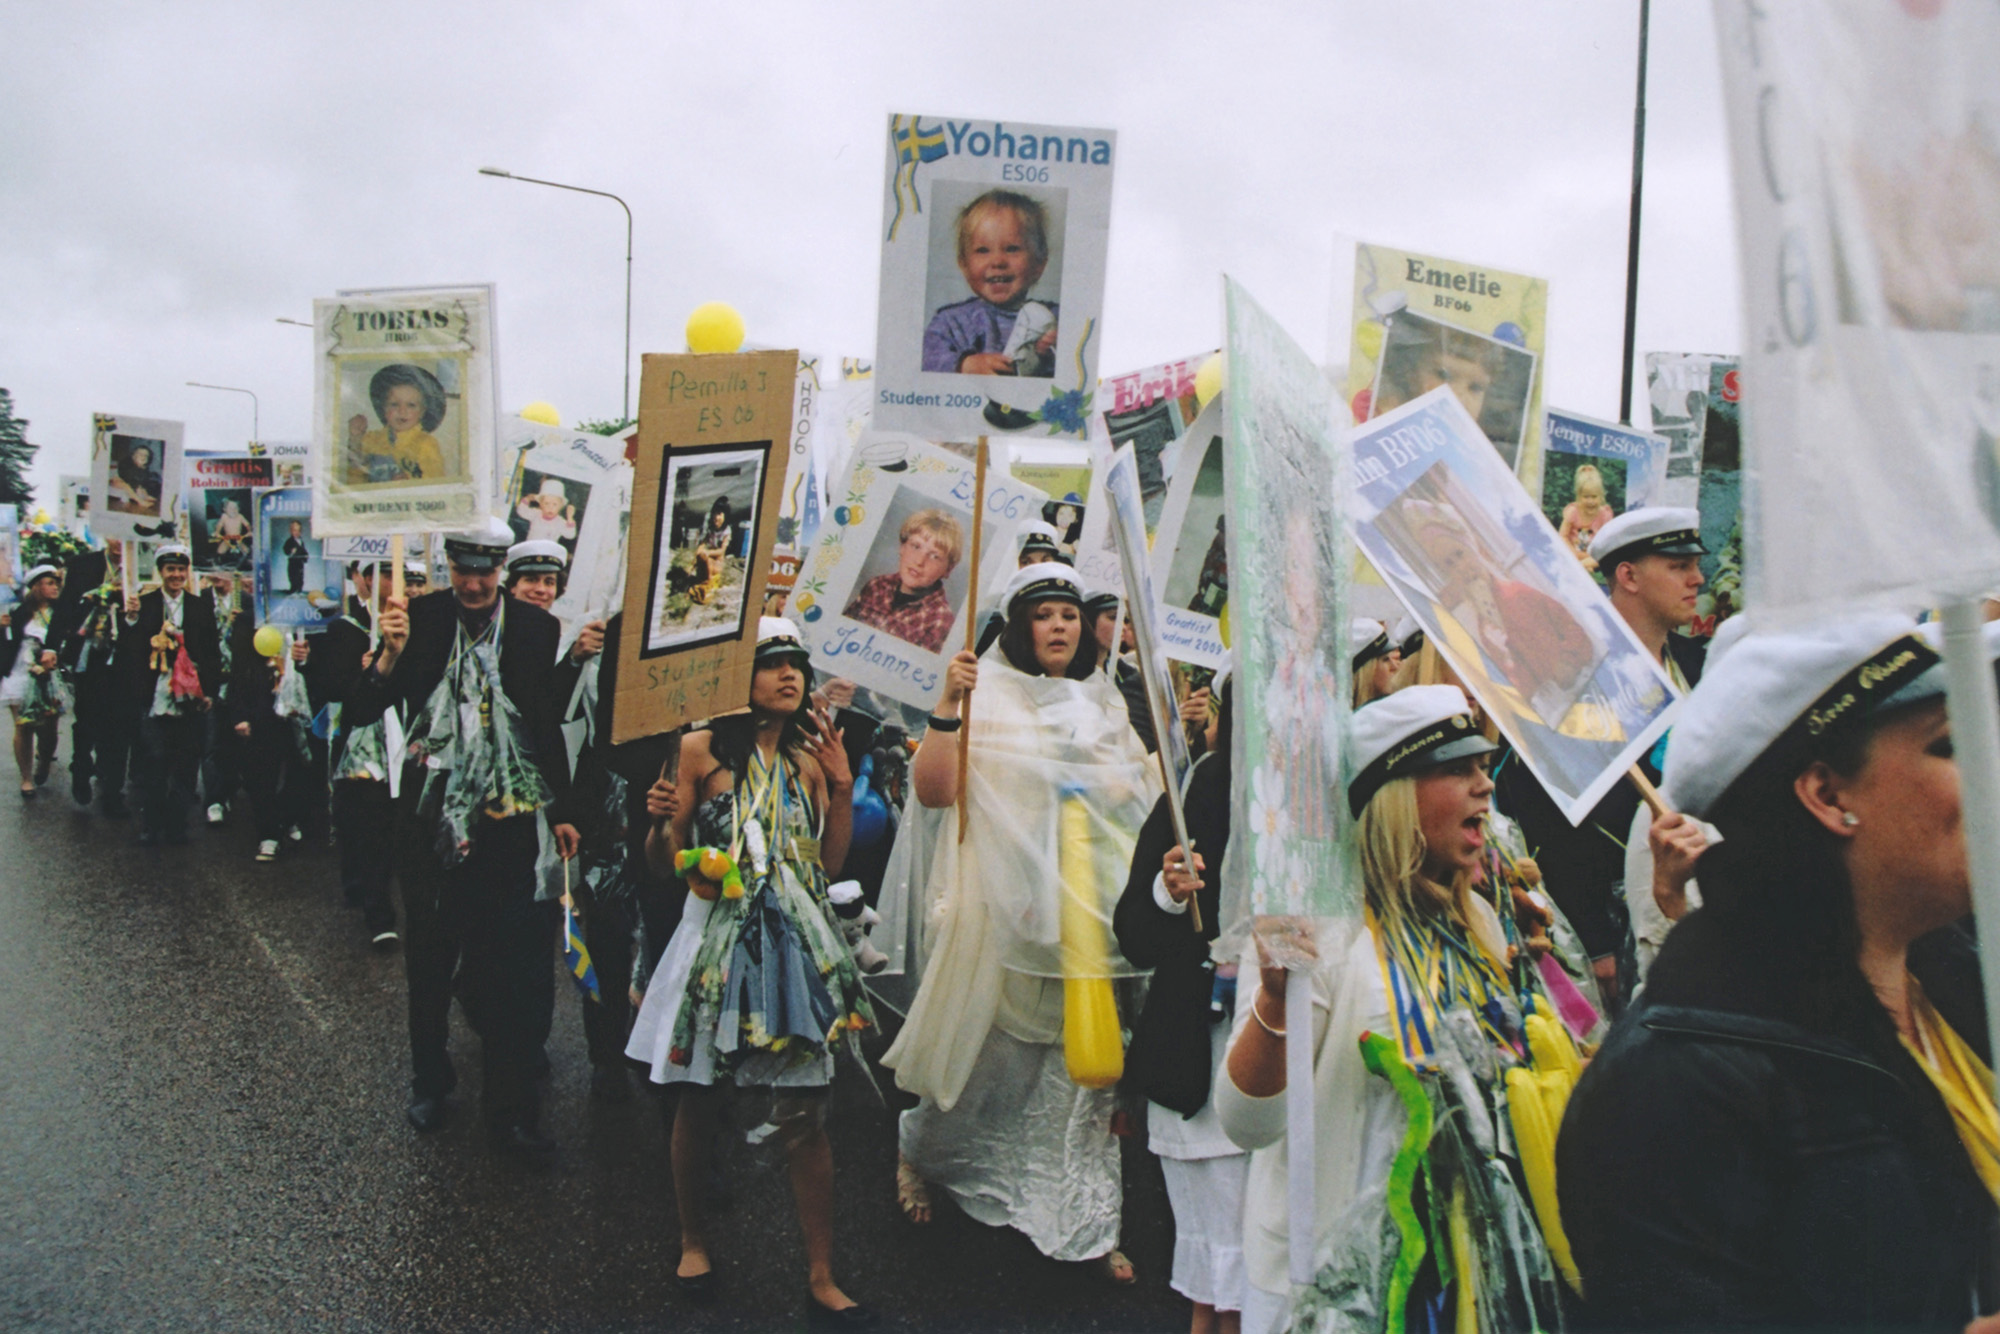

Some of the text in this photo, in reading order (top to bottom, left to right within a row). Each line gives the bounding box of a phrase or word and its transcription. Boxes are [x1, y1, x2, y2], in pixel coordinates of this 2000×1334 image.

[947, 121, 1110, 165] Yohanna
[1002, 164, 1049, 183] ES06
[1405, 258, 1501, 298] Emelie
[1433, 294, 1473, 313] BF06
[353, 309, 449, 332] TOBIAS
[880, 389, 982, 409] Student 2009
[1112, 362, 1197, 415] Erik
[697, 406, 723, 432] ES
[794, 382, 812, 454] HR06
[273, 446, 308, 455] JOHAN
[1375, 417, 1447, 469] BF06
[1546, 420, 1646, 459] Jenny ES06
[196, 459, 263, 475] Grattis
[191, 477, 229, 488] Robin
[987, 487, 1025, 520] 06
[347, 536, 389, 555] 2009
[304, 608, 322, 621] 06
[1166, 612, 1213, 635] Grattis!
[822, 625, 939, 693] Johannes
